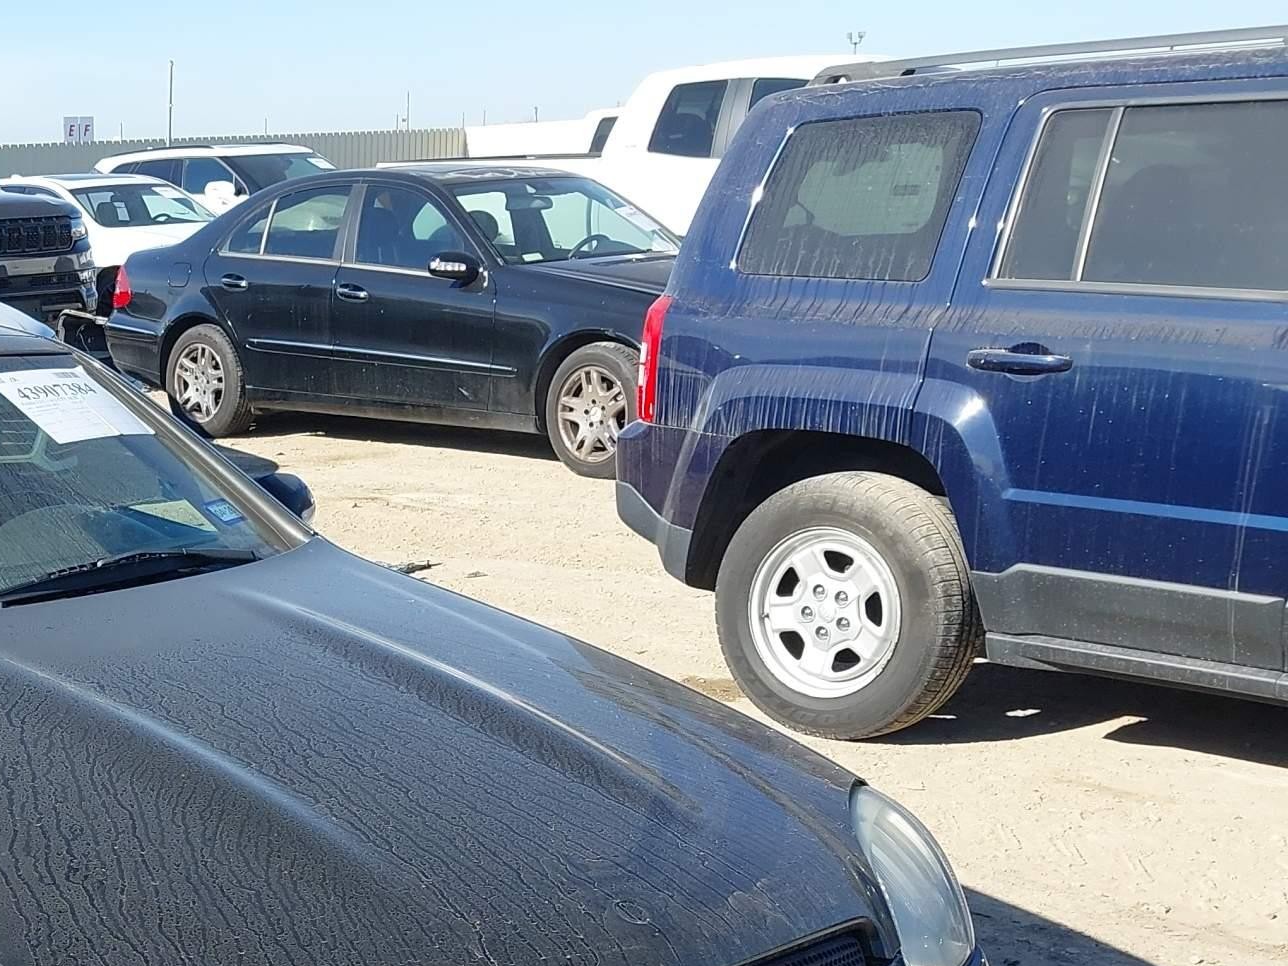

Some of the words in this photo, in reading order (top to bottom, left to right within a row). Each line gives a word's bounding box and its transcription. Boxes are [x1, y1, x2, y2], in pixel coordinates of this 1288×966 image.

[68, 124, 76, 137] E
[83, 124, 91, 137] F
[17, 382, 97, 401] 43907384
